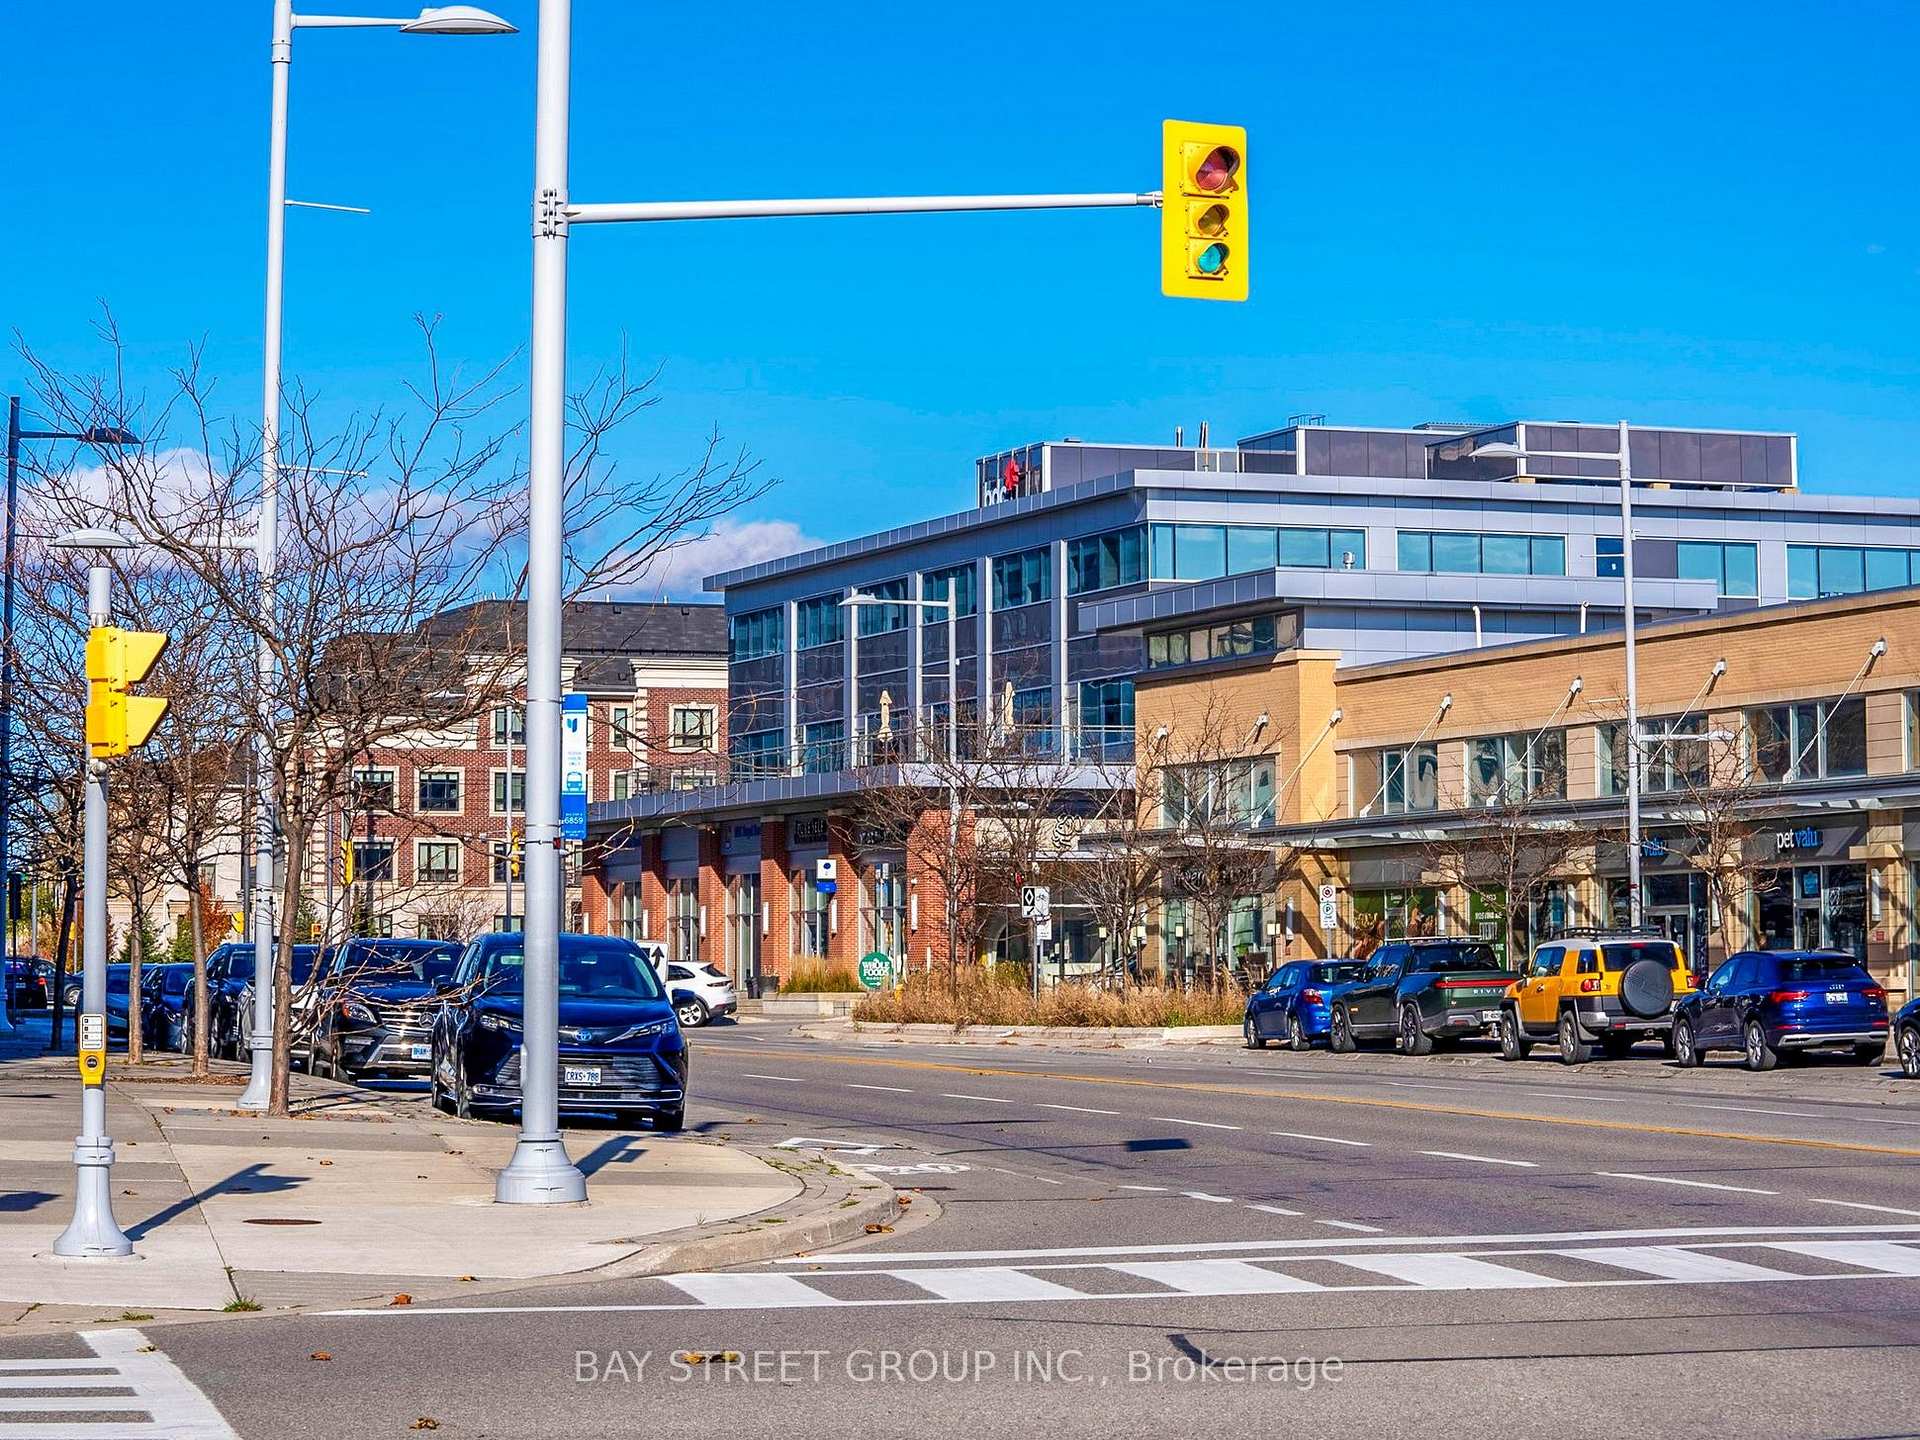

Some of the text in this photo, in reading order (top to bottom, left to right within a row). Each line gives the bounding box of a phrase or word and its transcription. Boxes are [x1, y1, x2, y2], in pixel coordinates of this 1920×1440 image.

[565, 817, 584, 825] 6859
[1776, 826, 1818, 854] pet valu
[862, 961, 891, 971] WHOLE
[863, 969, 889, 977] FOODS
